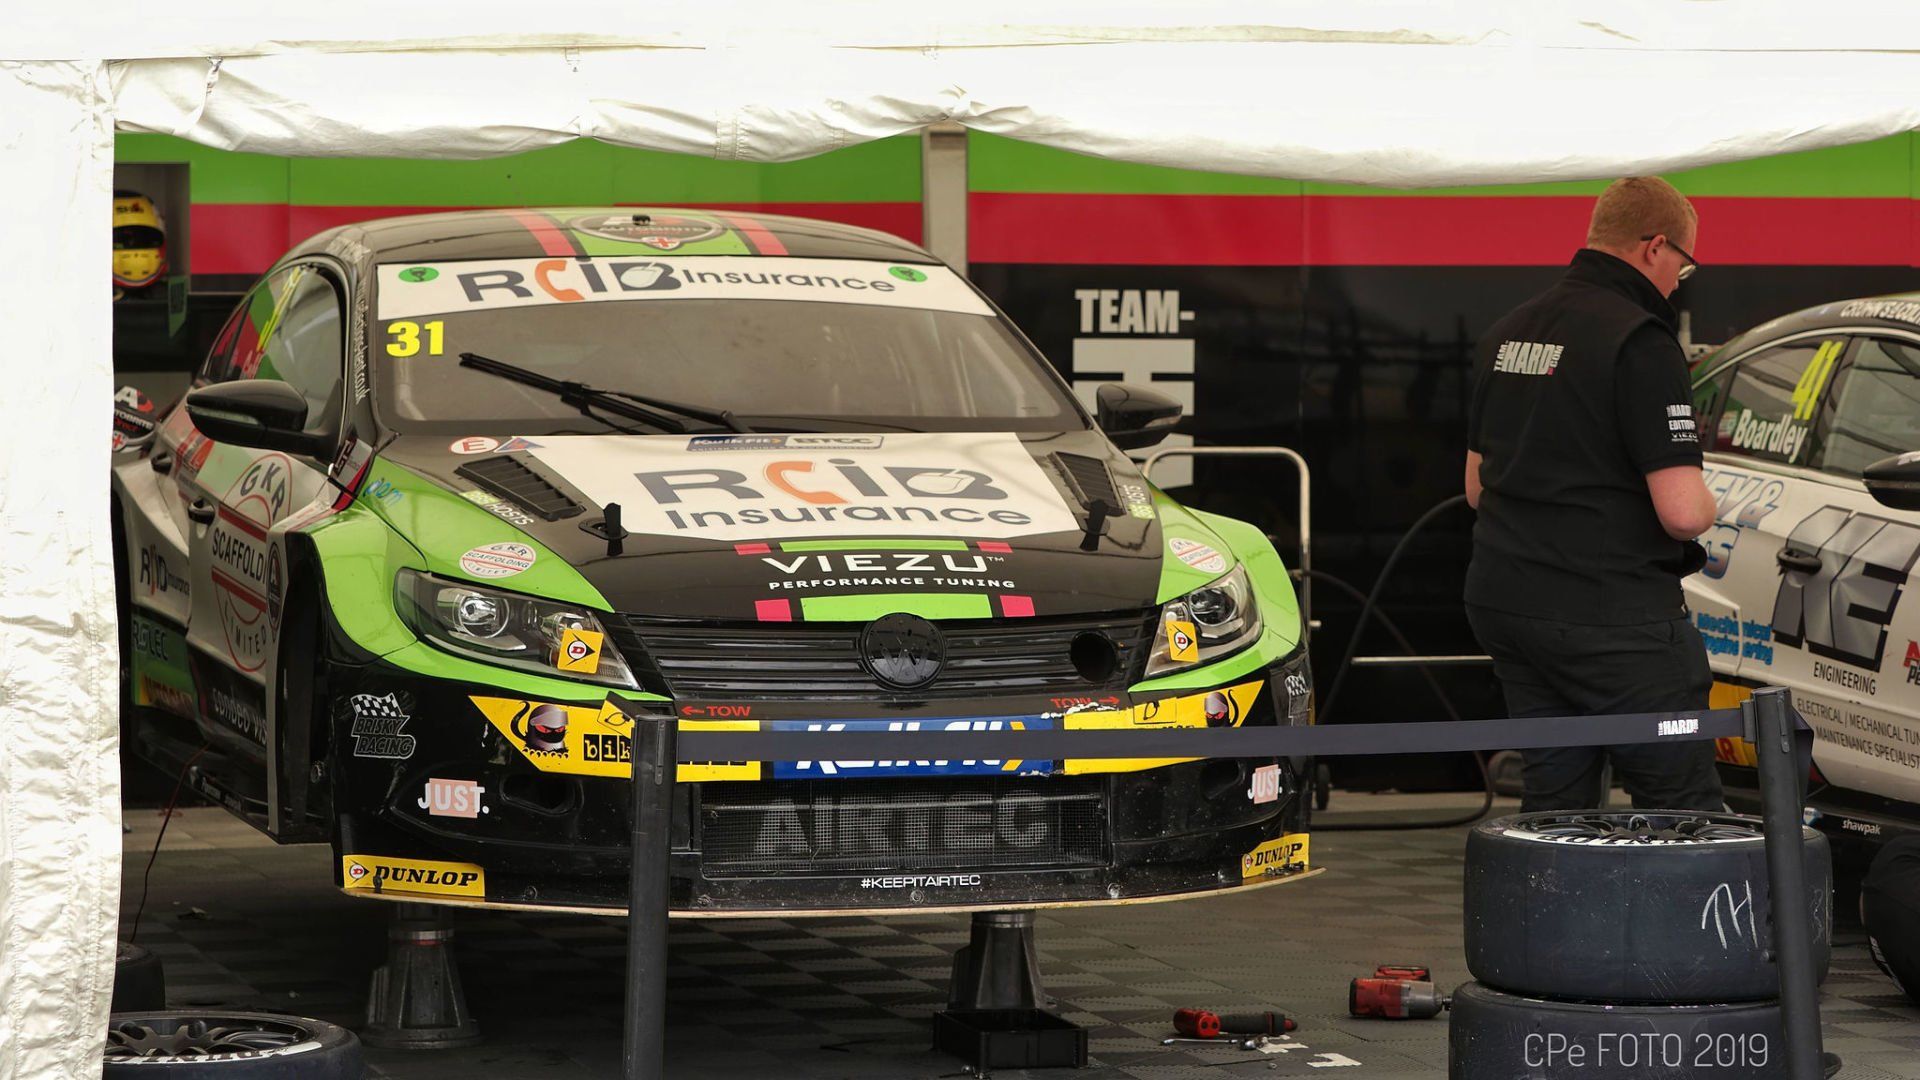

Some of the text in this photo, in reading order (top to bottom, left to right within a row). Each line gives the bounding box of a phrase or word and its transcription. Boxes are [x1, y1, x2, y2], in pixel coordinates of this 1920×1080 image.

[685, 269, 895, 292] Insurance
[386, 321, 444, 357] 31
[1501, 341, 1556, 375] HARD
[1792, 340, 1843, 420] 41
[463, 440, 487, 452] E
[1732, 409, 1808, 464] Boardley
[240, 462, 286, 521] GKR
[665, 505, 1031, 530] Insurance
[465, 551, 530, 568] SCAFFOLDING
[761, 554, 987, 574] VIEZU
[768, 576, 1016, 591] PERFORMANCE TUNING
[1813, 661, 1877, 696] ENGINEERING
[706, 706, 751, 717] TOW
[1797, 698, 1844, 724] ELECTRICAL
[1849, 713, 1903, 741] MECHANICAL
[354, 717, 404, 735] BRISKY
[357, 736, 413, 756] RACING
[1816, 726, 1874, 756] MAINTENANCE
[753, 790, 1048, 856] AIRTEC
[1842, 819, 1881, 836] shawpak
[1255, 843, 1303, 866] DUNLOP
[374, 865, 479, 888] DUNLOP
[860, 874, 981, 889] #KEEPITAIRTEC
